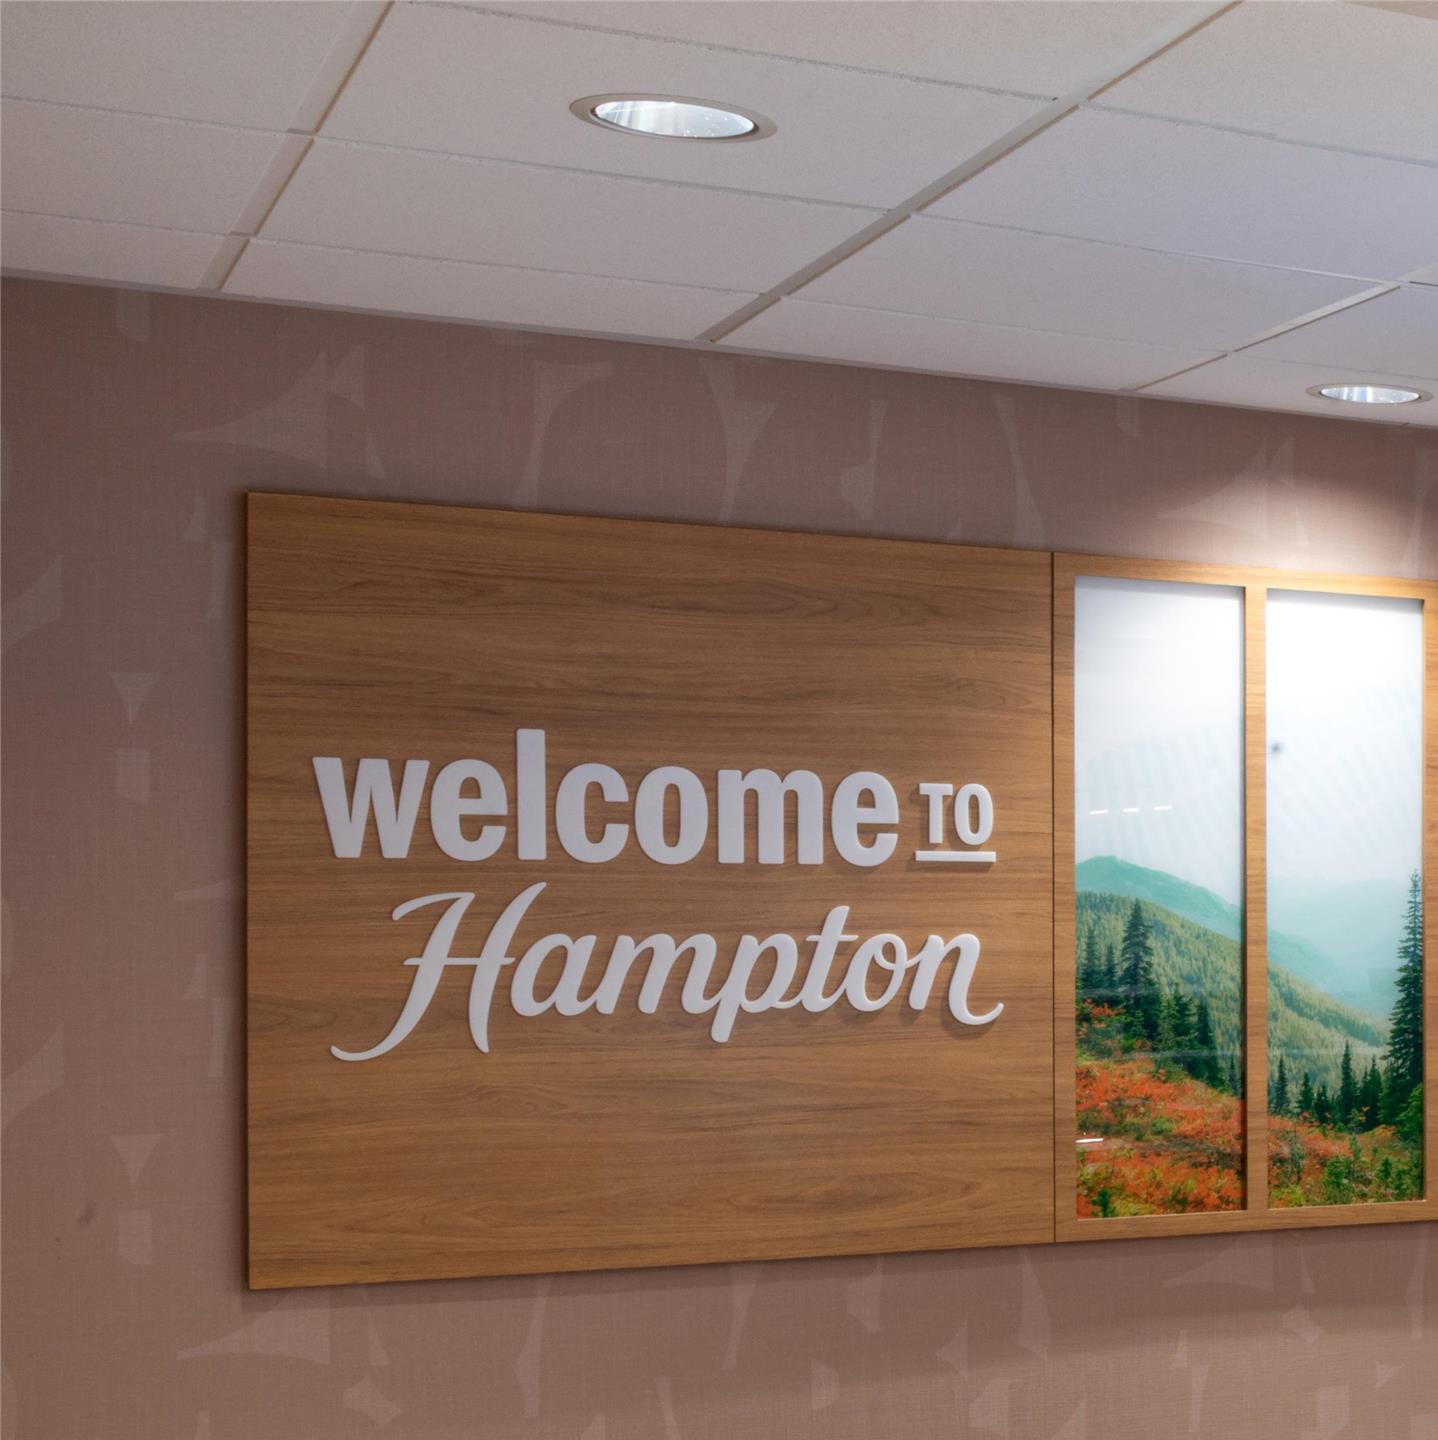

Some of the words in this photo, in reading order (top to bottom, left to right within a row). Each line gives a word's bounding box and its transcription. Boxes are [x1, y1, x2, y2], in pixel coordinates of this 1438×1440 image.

[312, 728, 900, 867] welcome
[918, 782, 995, 847] TO
[330, 881, 1005, 1062] Hampton
